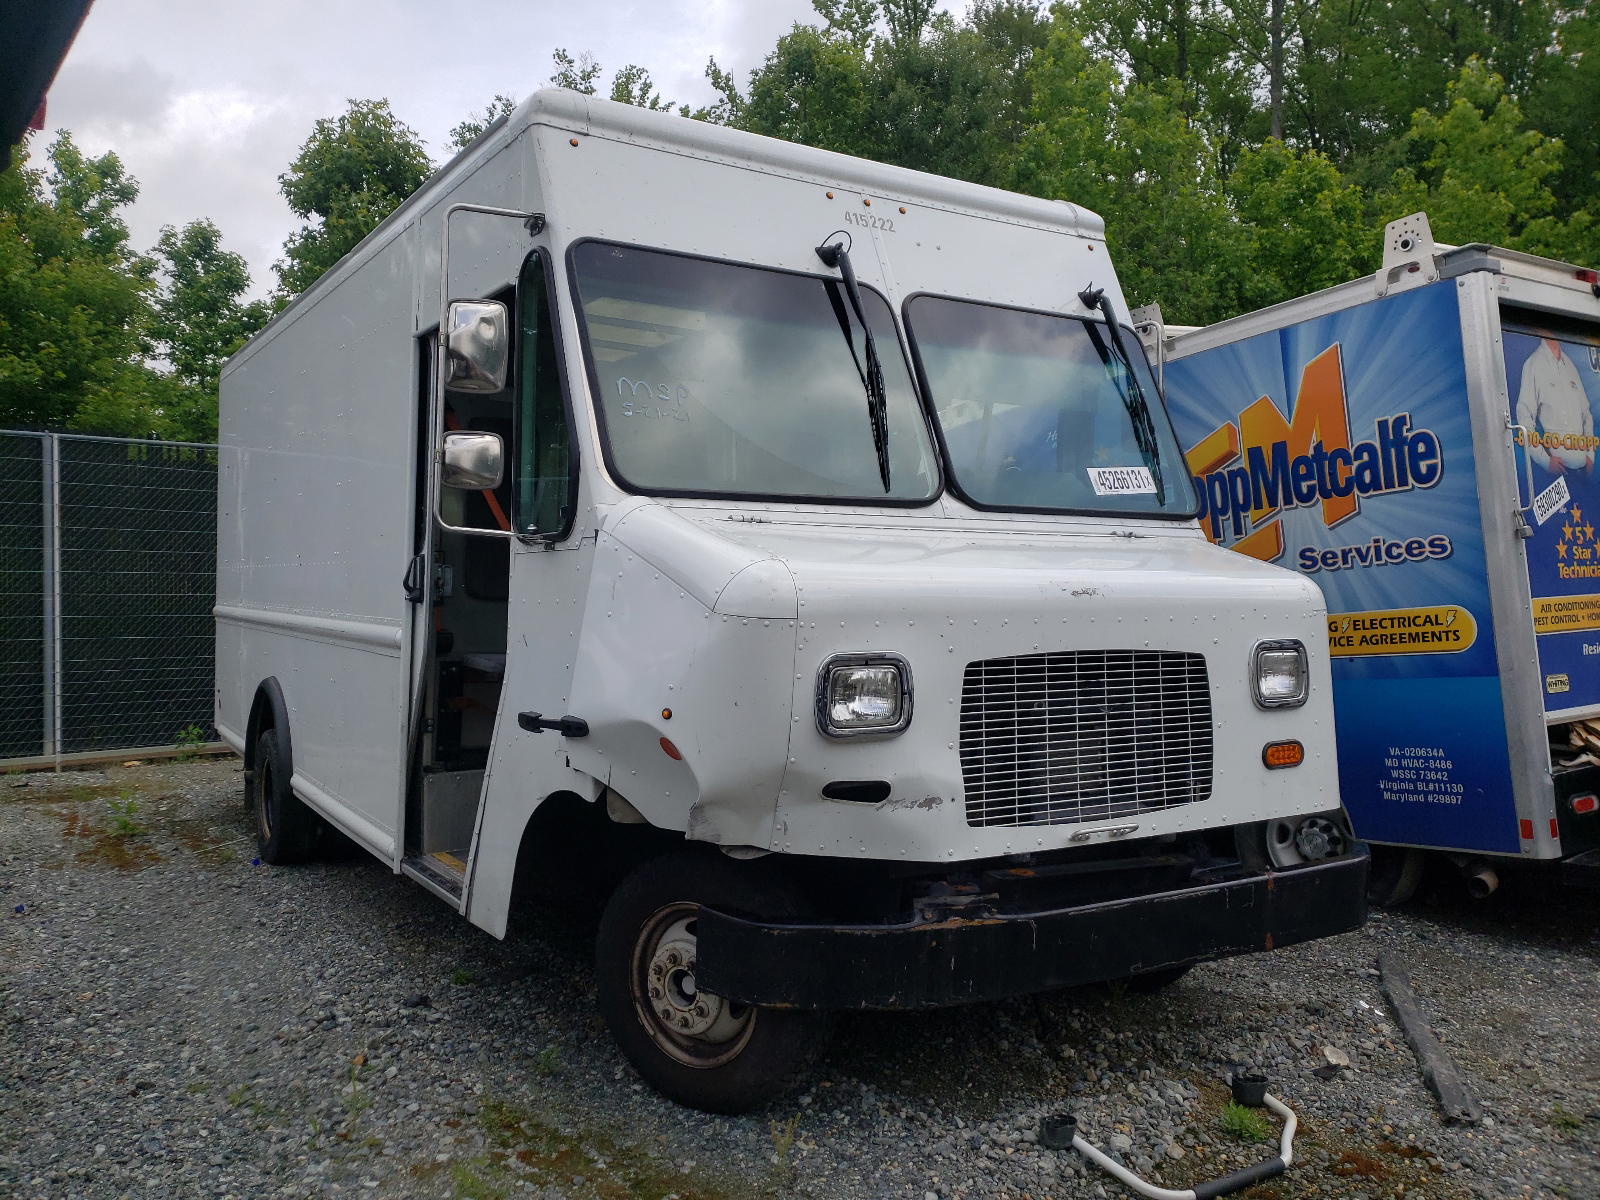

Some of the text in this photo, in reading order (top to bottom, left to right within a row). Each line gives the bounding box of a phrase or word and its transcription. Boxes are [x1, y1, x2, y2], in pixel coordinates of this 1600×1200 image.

[844, 211, 896, 232] 415222
[1575, 527, 1584, 544] 5
[1299, 534, 1450, 573] Services
[1573, 546, 1592, 560] Star
[1540, 604, 1552, 614] AIR
[1353, 614, 1444, 631] ELECTRICAL
[1534, 616, 1549, 626] PEST
[1551, 614, 1581, 625] CONTROL
[1359, 629, 1461, 647] AGREEMENTS
[1389, 747, 1445, 757] VA-020634A
[1384, 758, 1453, 769] MD HVAC-8486
[1391, 769, 1448, 780] WSSC 73642
[1379, 780, 1464, 793] Virginia BL#11130
[1383, 791, 1462, 805] Maryland #29897
